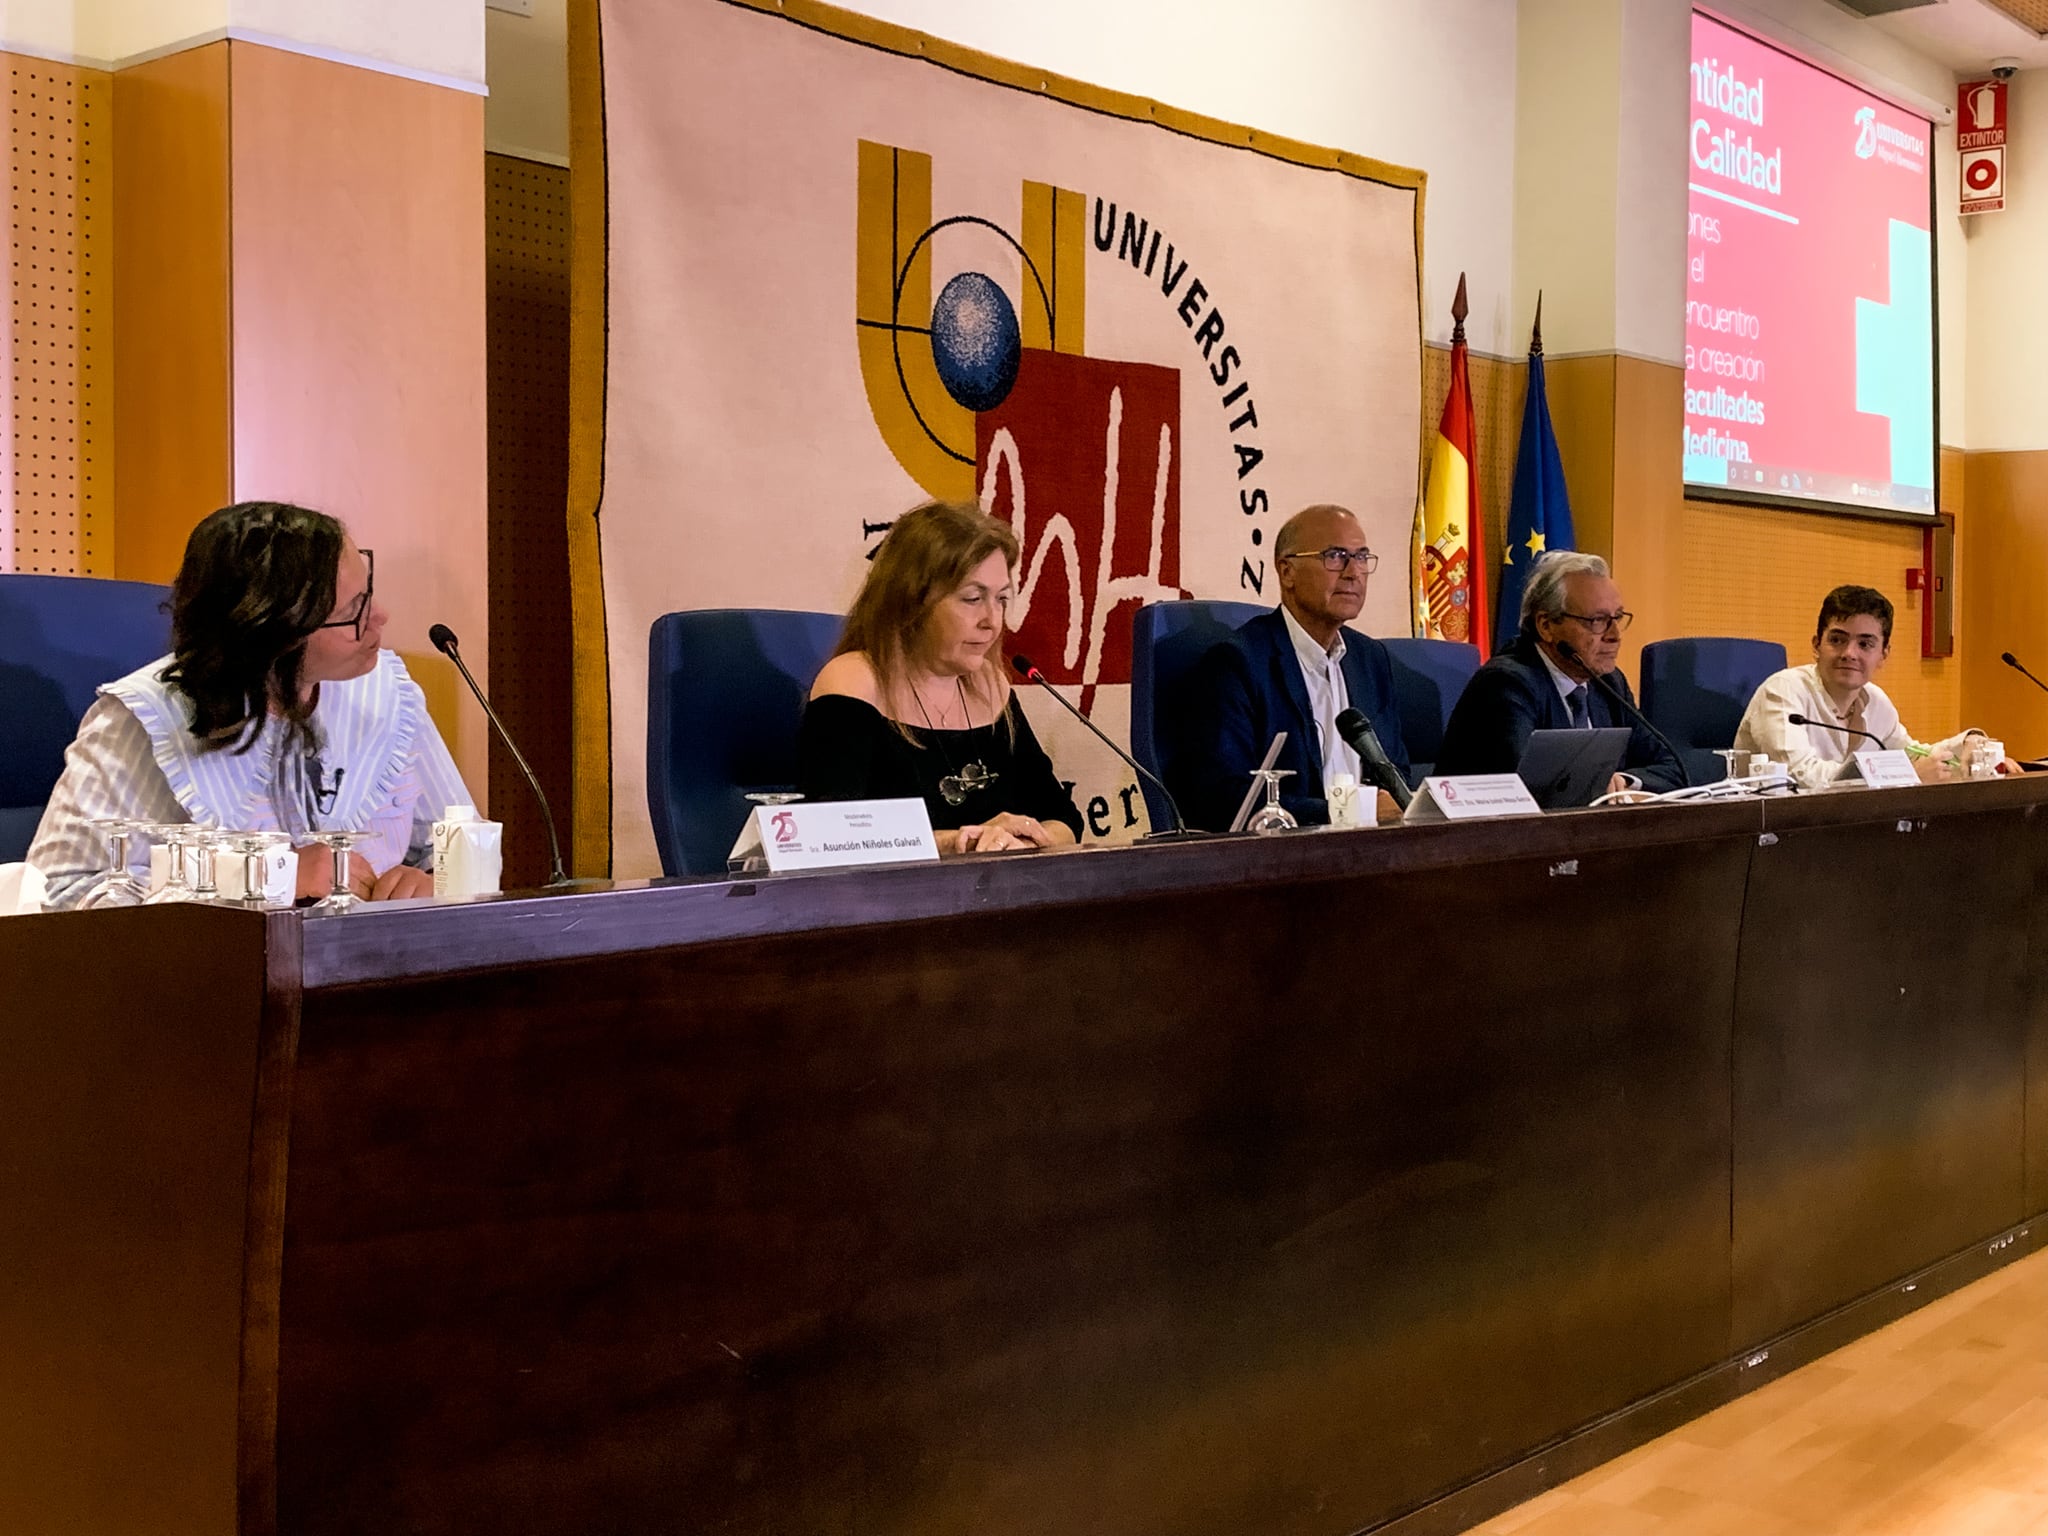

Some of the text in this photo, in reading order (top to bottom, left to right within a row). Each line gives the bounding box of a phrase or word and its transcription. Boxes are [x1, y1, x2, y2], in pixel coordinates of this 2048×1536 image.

[1691, 118, 1781, 195] Calidad
[1960, 130, 2004, 147] EXTINTOR
[1691, 250, 1704, 283] el
[1094, 197, 1269, 516] UNIVERSITAS
[1684, 380, 1764, 425] acultades
[823, 841, 861, 852] Asunción
[862, 838, 893, 850] Niñoles
